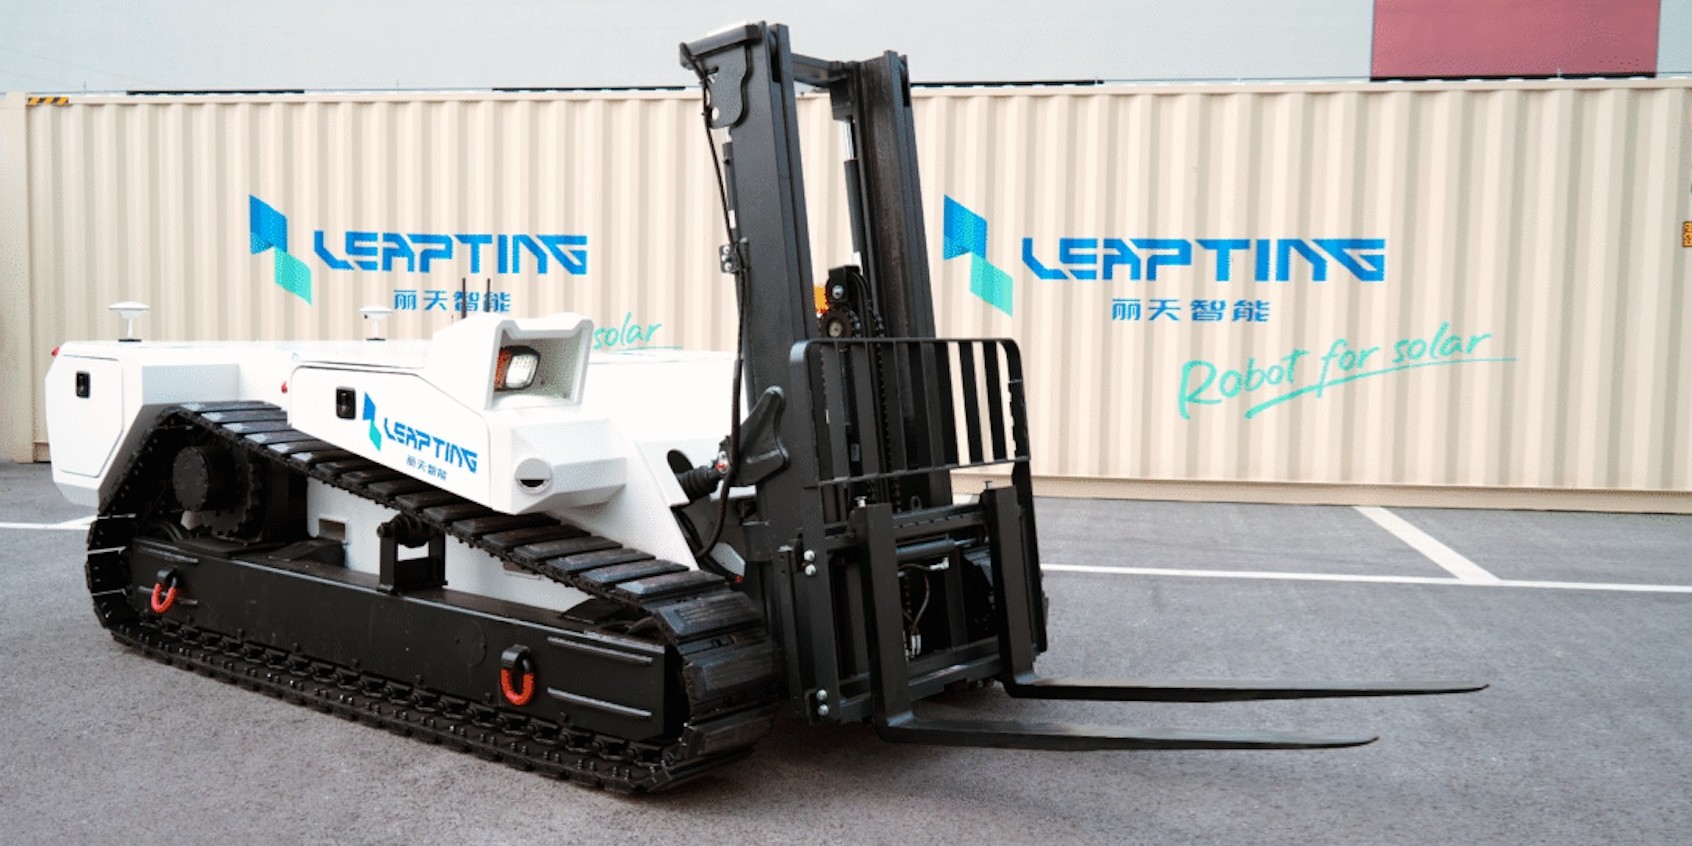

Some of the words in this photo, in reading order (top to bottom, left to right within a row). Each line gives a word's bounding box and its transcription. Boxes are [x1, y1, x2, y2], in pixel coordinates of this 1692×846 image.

[314, 230, 588, 275] LEAPTING
[1022, 237, 1386, 282] LEAPTING
[393, 289, 511, 312] 丽天智能
[1112, 298, 1270, 323] 丽天智能
[593, 311, 662, 350] solar
[1178, 350, 1309, 420] Robot
[1316, 338, 1380, 398] for
[1391, 321, 1492, 364] solar
[384, 417, 478, 474] LEAPTING
